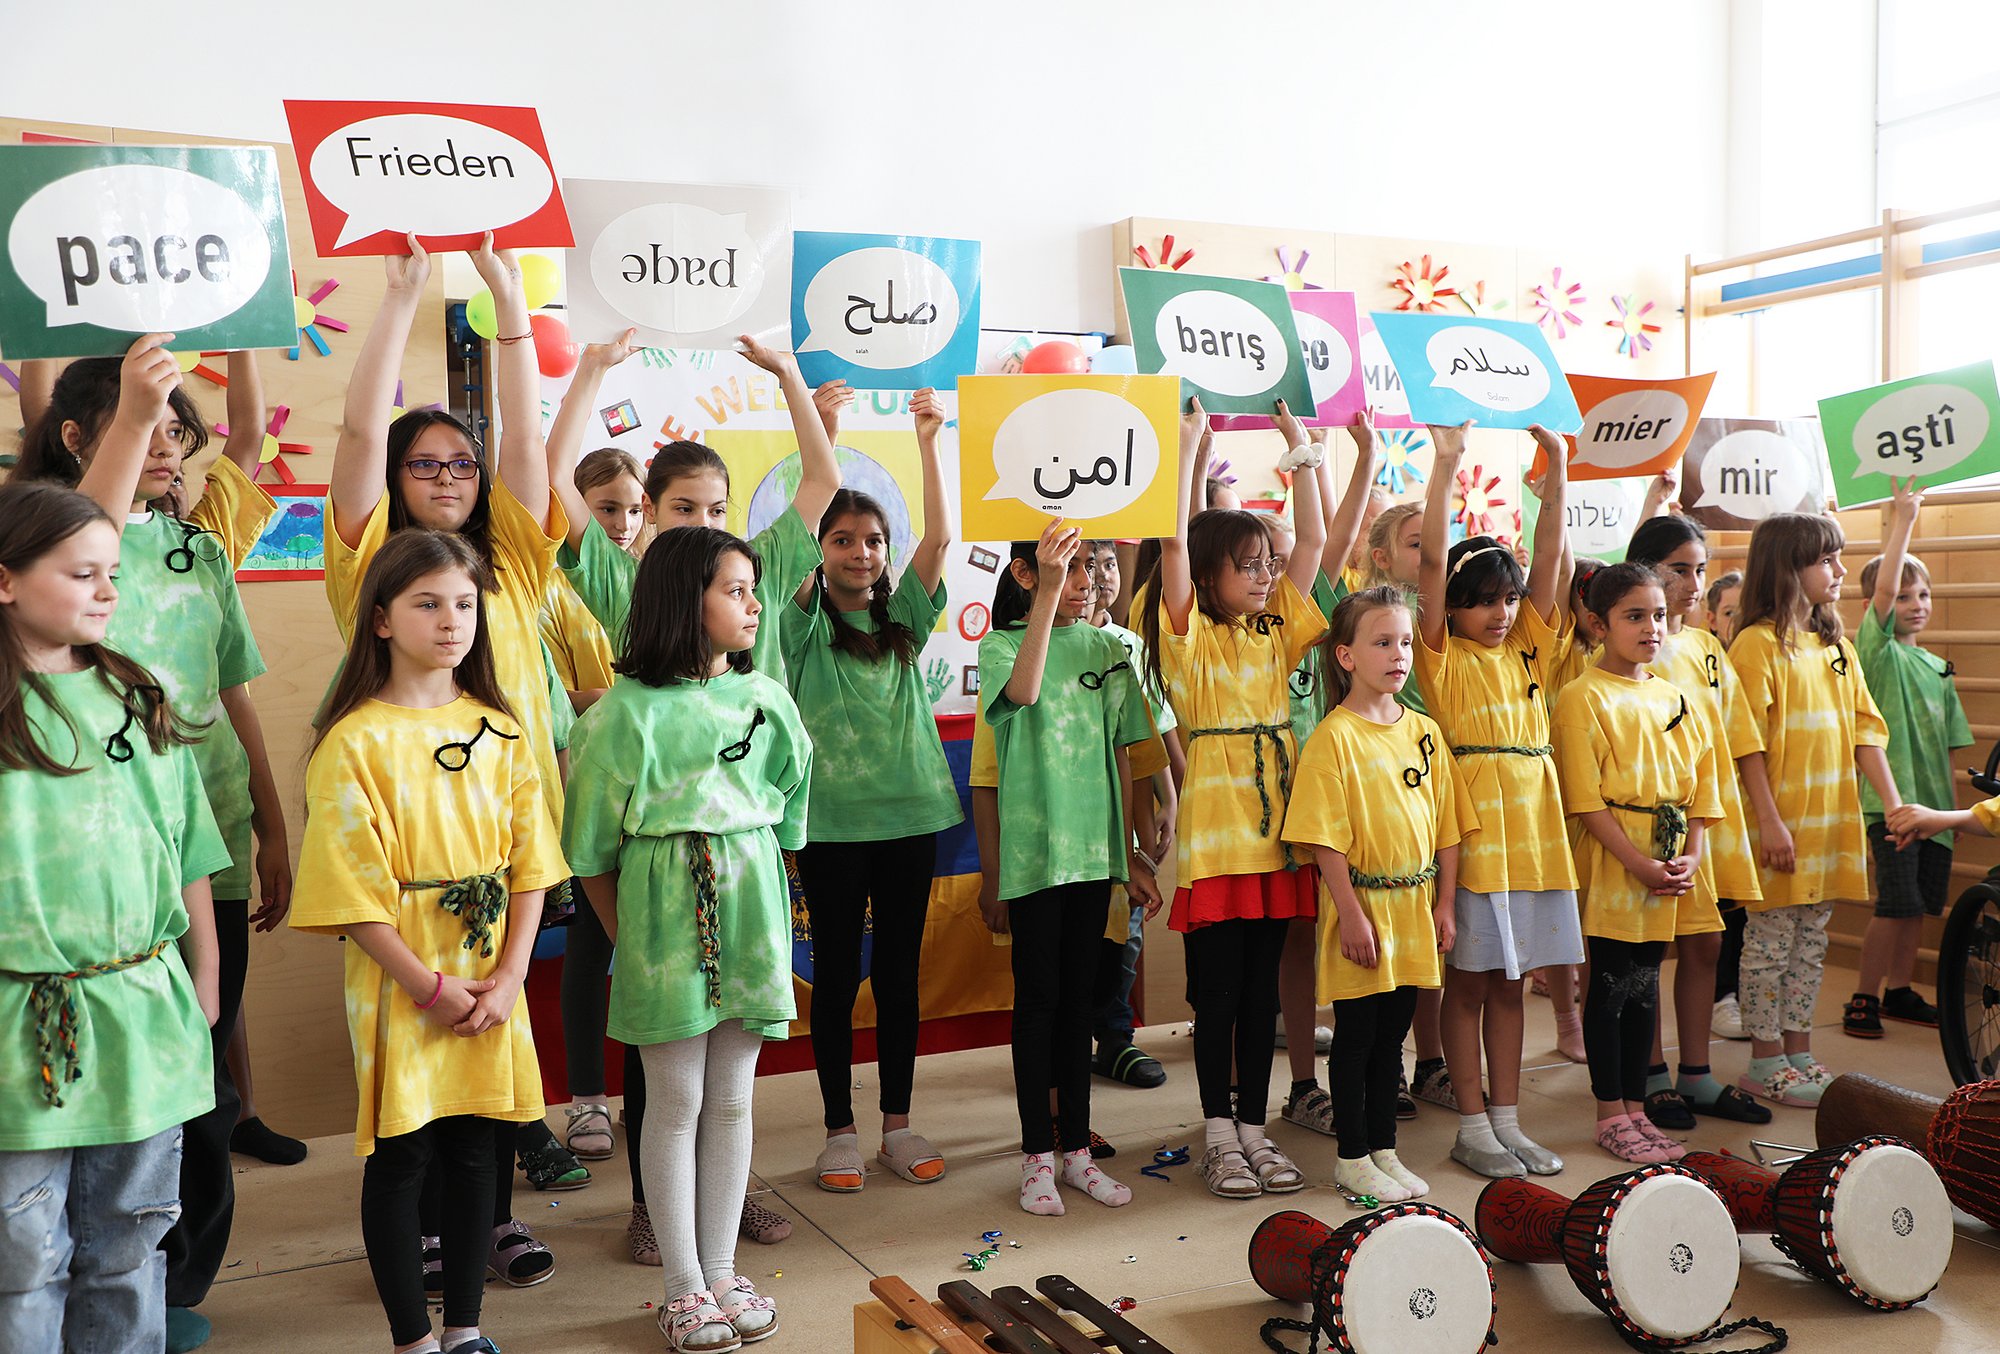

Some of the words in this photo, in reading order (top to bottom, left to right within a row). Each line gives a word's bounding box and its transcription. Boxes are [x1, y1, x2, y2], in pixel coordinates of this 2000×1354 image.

[346, 136, 515, 178] Frieden
[57, 233, 230, 306] pace
[622, 243, 738, 288] paqe
[845, 279, 937, 335] صلح
[1176, 315, 1266, 371] barış
[1450, 347, 1530, 375] سلام
[1593, 413, 1672, 443] mier
[1877, 404, 1956, 463] aştî
[1034, 428, 1134, 500] امن
[1721, 458, 1779, 496] mir
